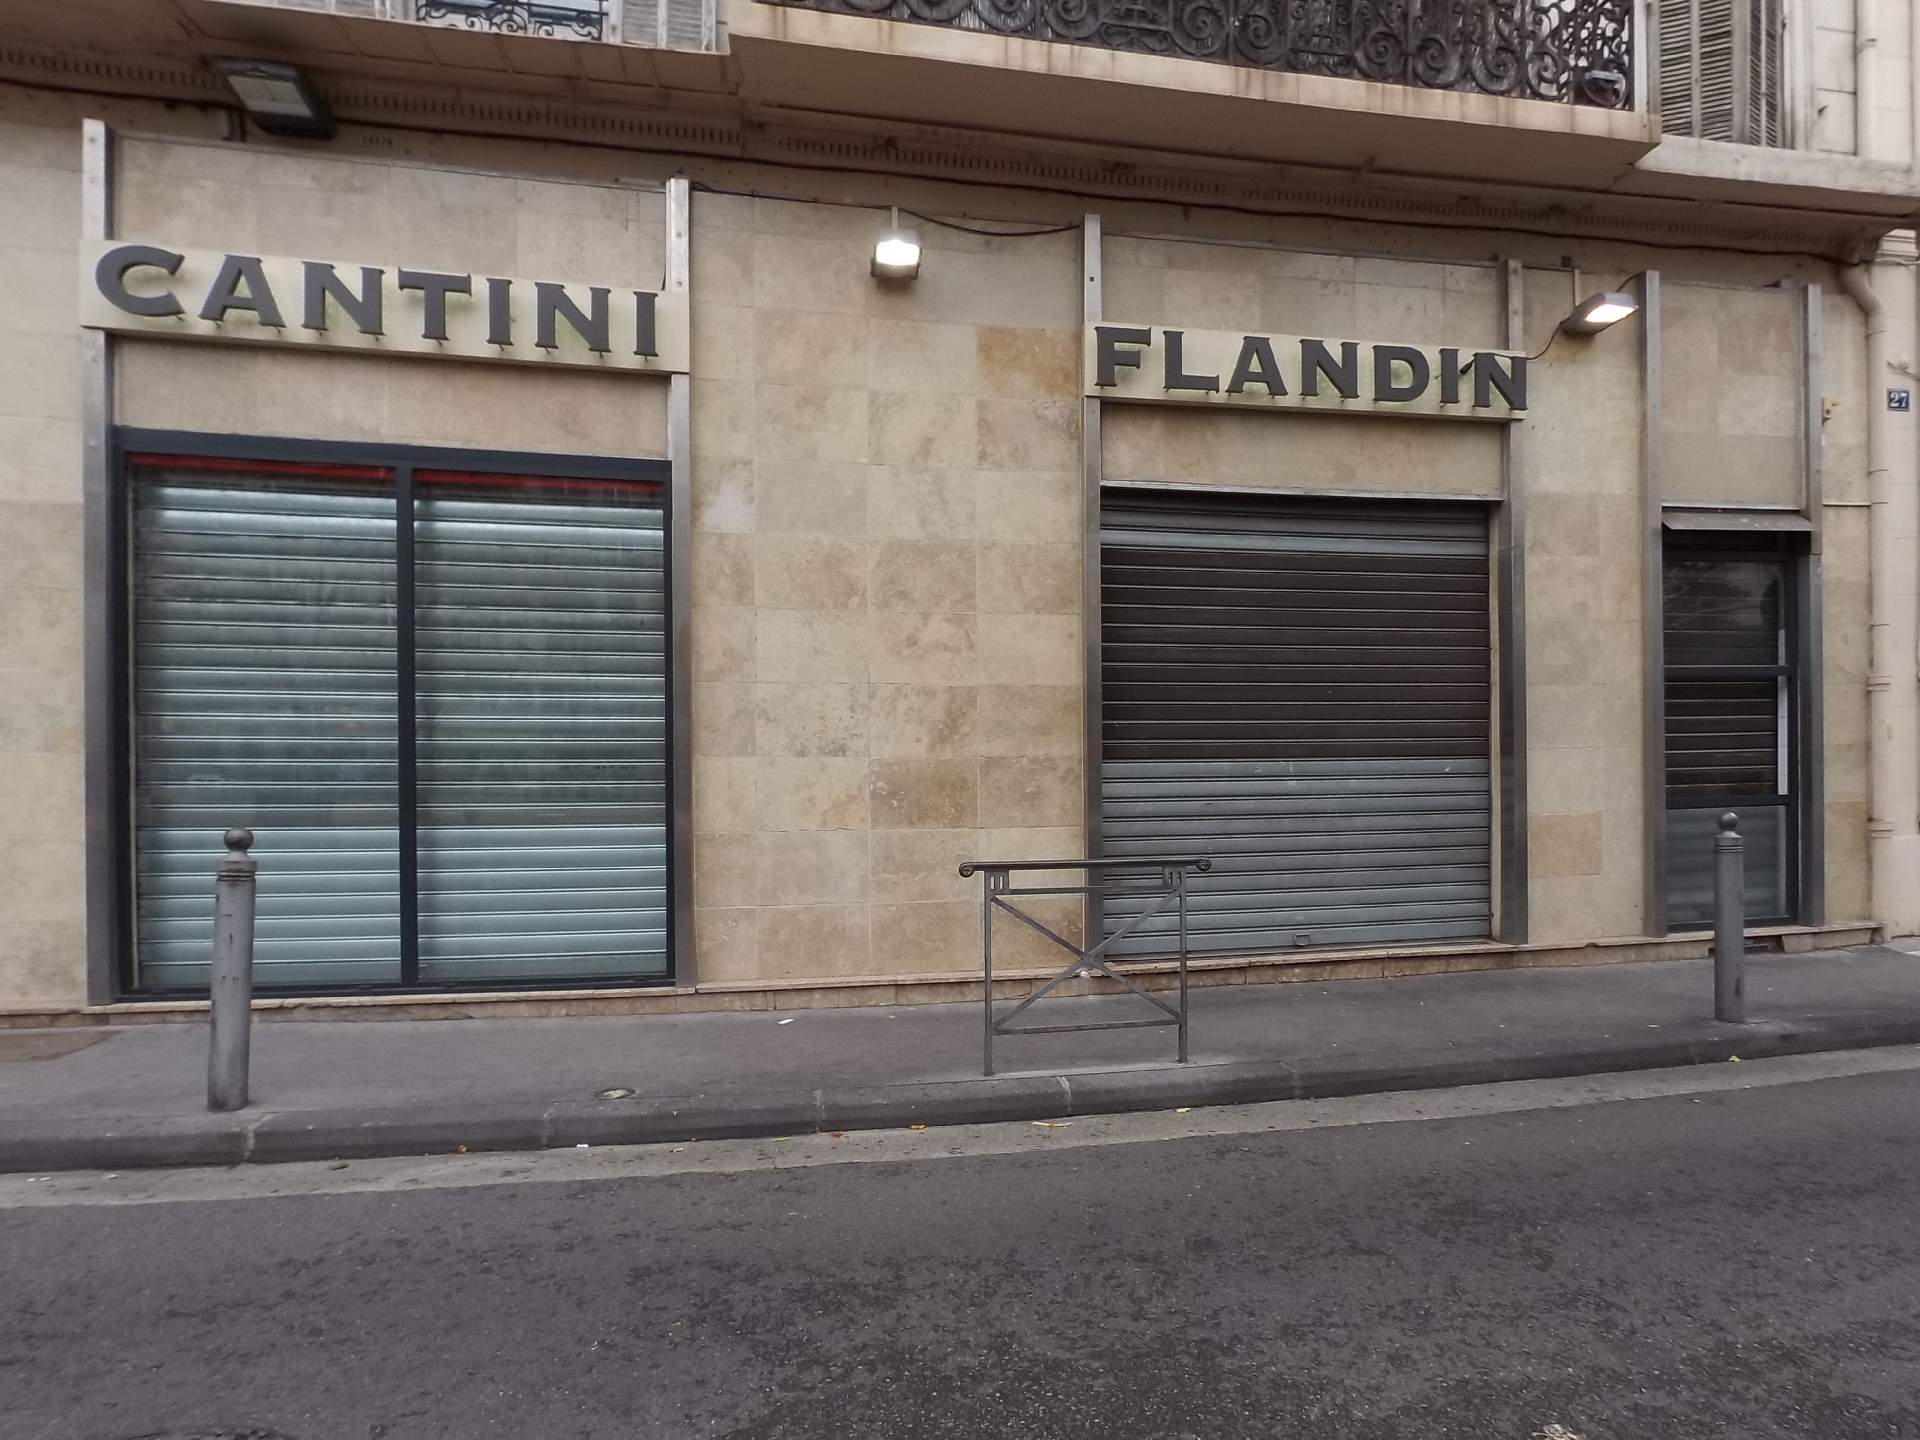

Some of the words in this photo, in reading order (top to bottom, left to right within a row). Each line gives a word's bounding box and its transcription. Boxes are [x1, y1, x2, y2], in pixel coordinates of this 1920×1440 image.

[95, 244, 659, 358] CANTINI
[1094, 326, 1527, 411] FLANDIN
[1889, 391, 1908, 408] 27
